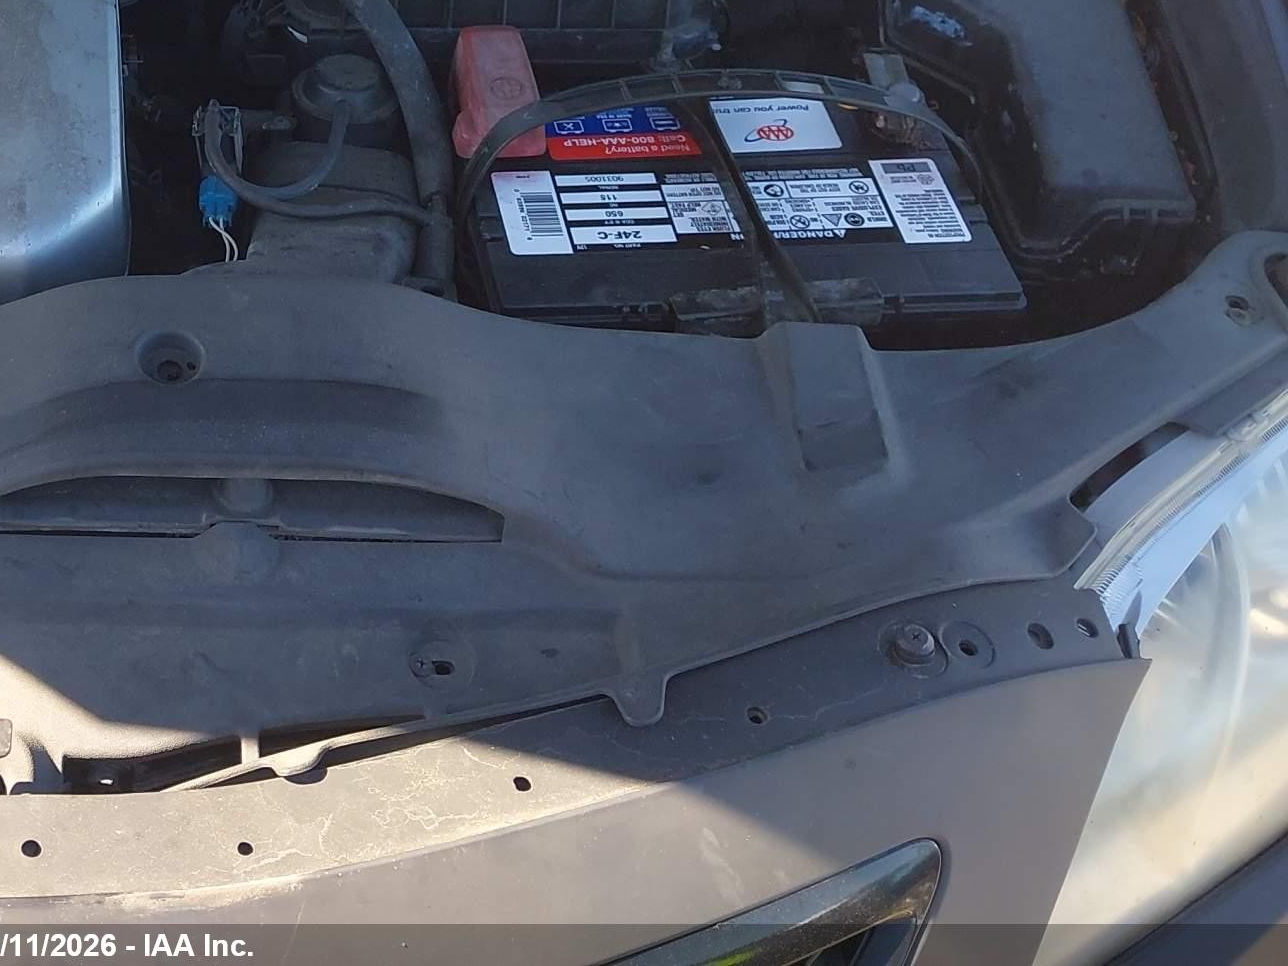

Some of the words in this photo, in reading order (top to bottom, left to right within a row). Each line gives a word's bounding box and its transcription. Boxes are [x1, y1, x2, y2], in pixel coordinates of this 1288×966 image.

[777, 104, 809, 112] Power
[757, 126, 793, 140] AAA
[563, 136, 655, 147] 800-AAA-HELP
[658, 134, 686, 142] Call:
[604, 144, 649, 154] battery?
[660, 144, 689, 152] Need
[600, 194, 618, 202] 115
[604, 210, 624, 218] 650
[597, 230, 642, 240] 24F-C
